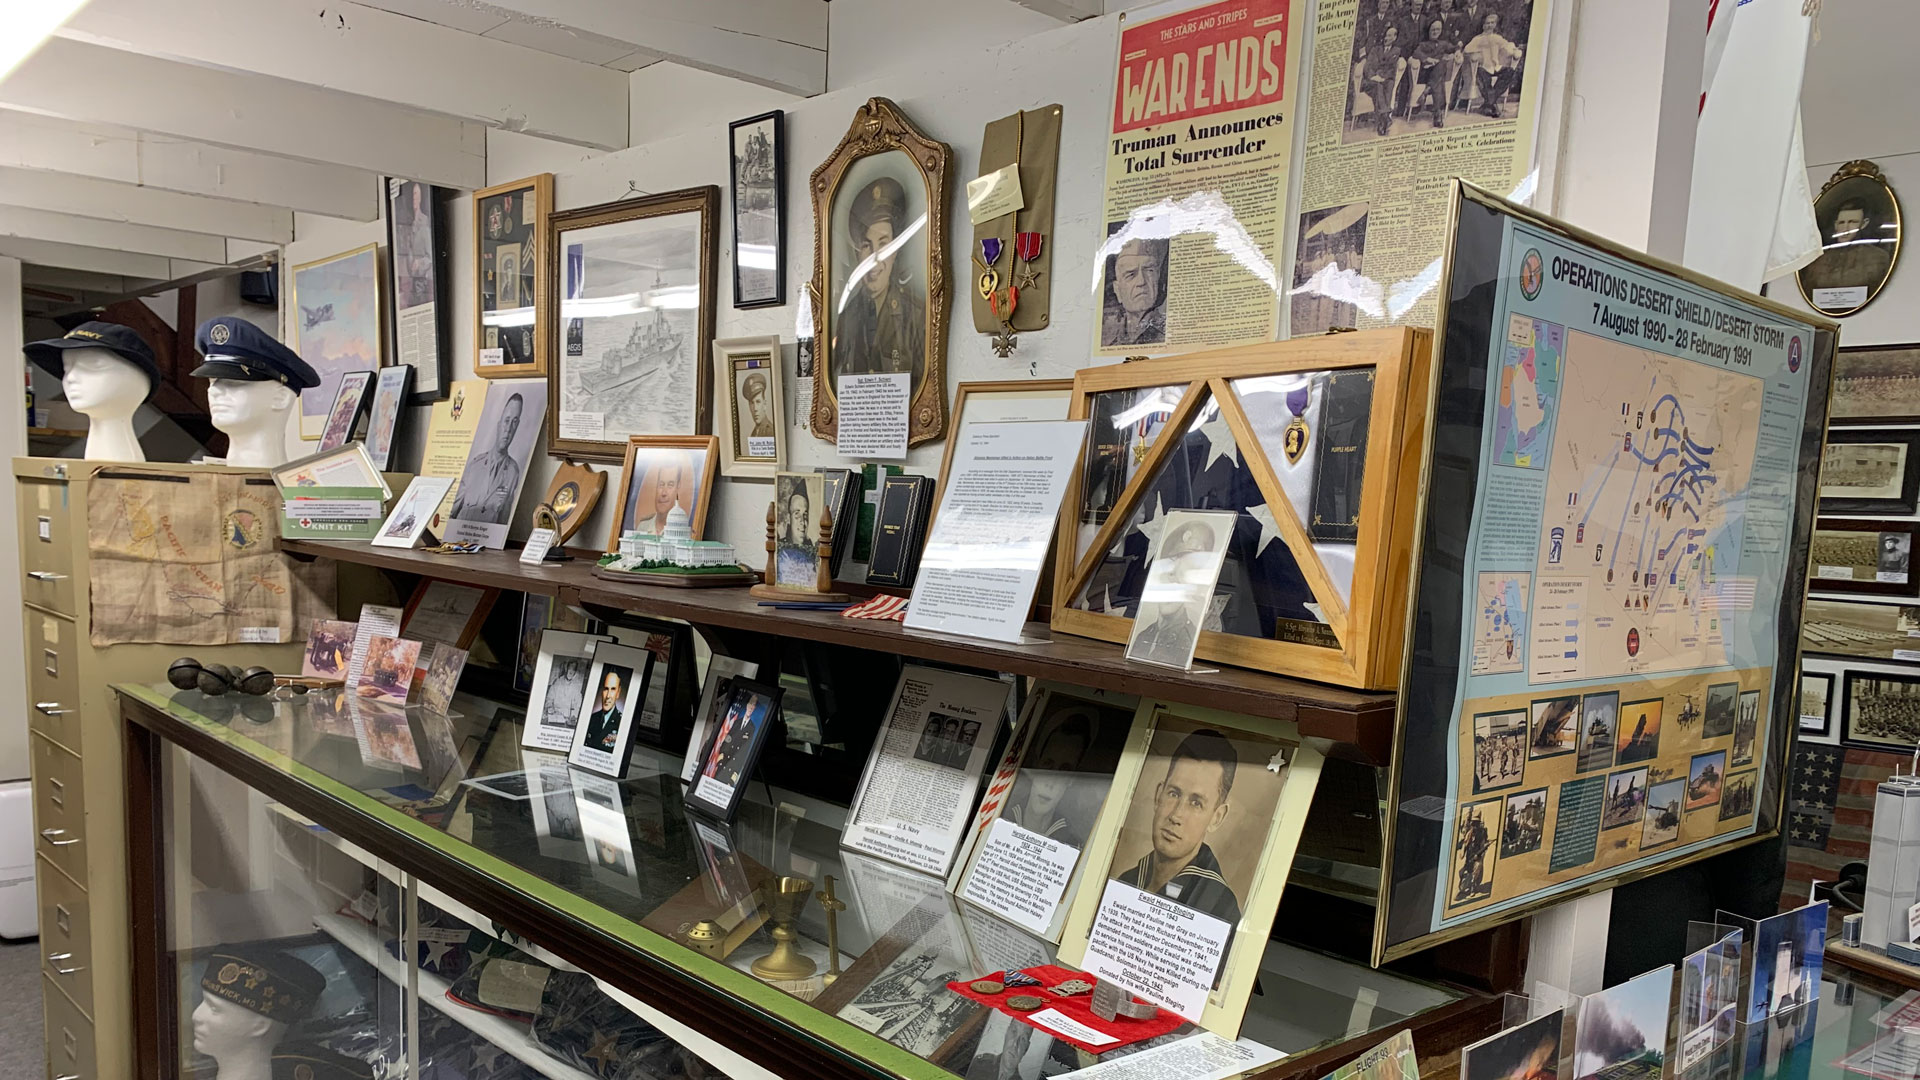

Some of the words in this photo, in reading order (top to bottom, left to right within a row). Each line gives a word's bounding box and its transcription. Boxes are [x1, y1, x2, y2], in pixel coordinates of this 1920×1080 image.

[1161, 29, 1173, 41] THE
[1176, 22, 1197, 36] STARS
[1198, 17, 1215, 30] AND
[1217, 8, 1248, 25] STRIPES
[1317, 25, 1325, 34] To
[1326, 22, 1342, 32] Give
[1343, 19, 1354, 30] Up
[1318, 11, 1334, 22] Tells
[1336, 9, 1354, 18] Army
[1123, 52, 1190, 124] WAR
[1194, 30, 1282, 109] ENDS
[1112, 133, 1176, 156] Truman
[1185, 113, 1283, 142] Announces
[1420, 145, 1432, 154] Sets
[1434, 145, 1444, 153] Off
[1446, 143, 1459, 151] New
[1461, 140, 1473, 149] U.S.
[1476, 137, 1515, 147] Celebrations
[1422, 136, 1445, 147] Tokyo's
[1447, 132, 1468, 144] Report
[1482, 129, 1516, 140] Acceptance
[1124, 151, 1166, 174] Total
[1172, 136, 1266, 166] Surrender
[1416, 176, 1431, 184] Peace
[1552, 256, 1628, 302] OPERATIONS
[1629, 283, 1674, 316] DESERT
[1753, 323, 1784, 350] STORM
[568, 343, 581, 352] AEGIS
[1593, 302, 1600, 324] 7
[1600, 305, 1640, 336] August
[1642, 318, 1667, 343] 1990
[1675, 327, 1688, 349] 28
[1690, 332, 1731, 365] February
[1733, 345, 1752, 367] 1991
[1344, 445, 1357, 453] HEART
[160, 515, 187, 558] PACIFIC
[190, 564, 223, 592] OCEAN
[907, 825, 920, 835] Navy
[1015, 902, 1030, 913] Admiral
[1029, 909, 1043, 920] Halsey
[1139, 893, 1156, 904] Ewald
[1155, 899, 1172, 911] Henry
[1120, 913, 1132, 923] They
[1132, 917, 1142, 926] had
[1156, 927, 1176, 940] Richard
[1146, 913, 1165, 926] Pauline
[1176, 925, 1188, 936] Gray
[1196, 934, 1219, 948] January
[1166, 912, 1178, 922] 1943
[1100, 914, 1109, 922] The
[1109, 918, 1123, 927] attack
[1130, 926, 1143, 935] Pearl
[1143, 931, 1161, 942] Harbor
[1161, 938, 1188, 954] December
[1097, 922, 1121, 936] demanded
[1121, 932, 1133, 941] more
[1134, 937, 1153, 949] soldiers
[1164, 949, 1181, 960] Ewald
[1192, 961, 1213, 974] drafted
[1101, 932, 1117, 943] service
[1145, 950, 1159, 961] While
[1160, 957, 1180, 971] serving
[1186, 968, 1196, 976] the
[1092, 938, 1108, 948] pacific
[1118, 948, 1126, 956] the
[1127, 952, 1134, 960] US
[1135, 955, 1147, 966] Navy
[1166, 968, 1182, 980] Killed
[1181, 976, 1200, 989] during
[1200, 983, 1210, 992] the
[1122, 968, 1142, 982] October
[1137, 965, 1153, 977] Island
[1153, 972, 1179, 988] Campaign
[1099, 967, 1119, 980] Donated
[1119, 976, 1126, 984] by
[1126, 979, 1134, 987] his
[1134, 984, 1145, 992] wife
[1145, 987, 1165, 1001] Pauline
[1164, 996, 1185, 1012] Staging
[1356, 1052, 1378, 1074] FLIGHT
[1380, 1047, 1388, 1060] 93
